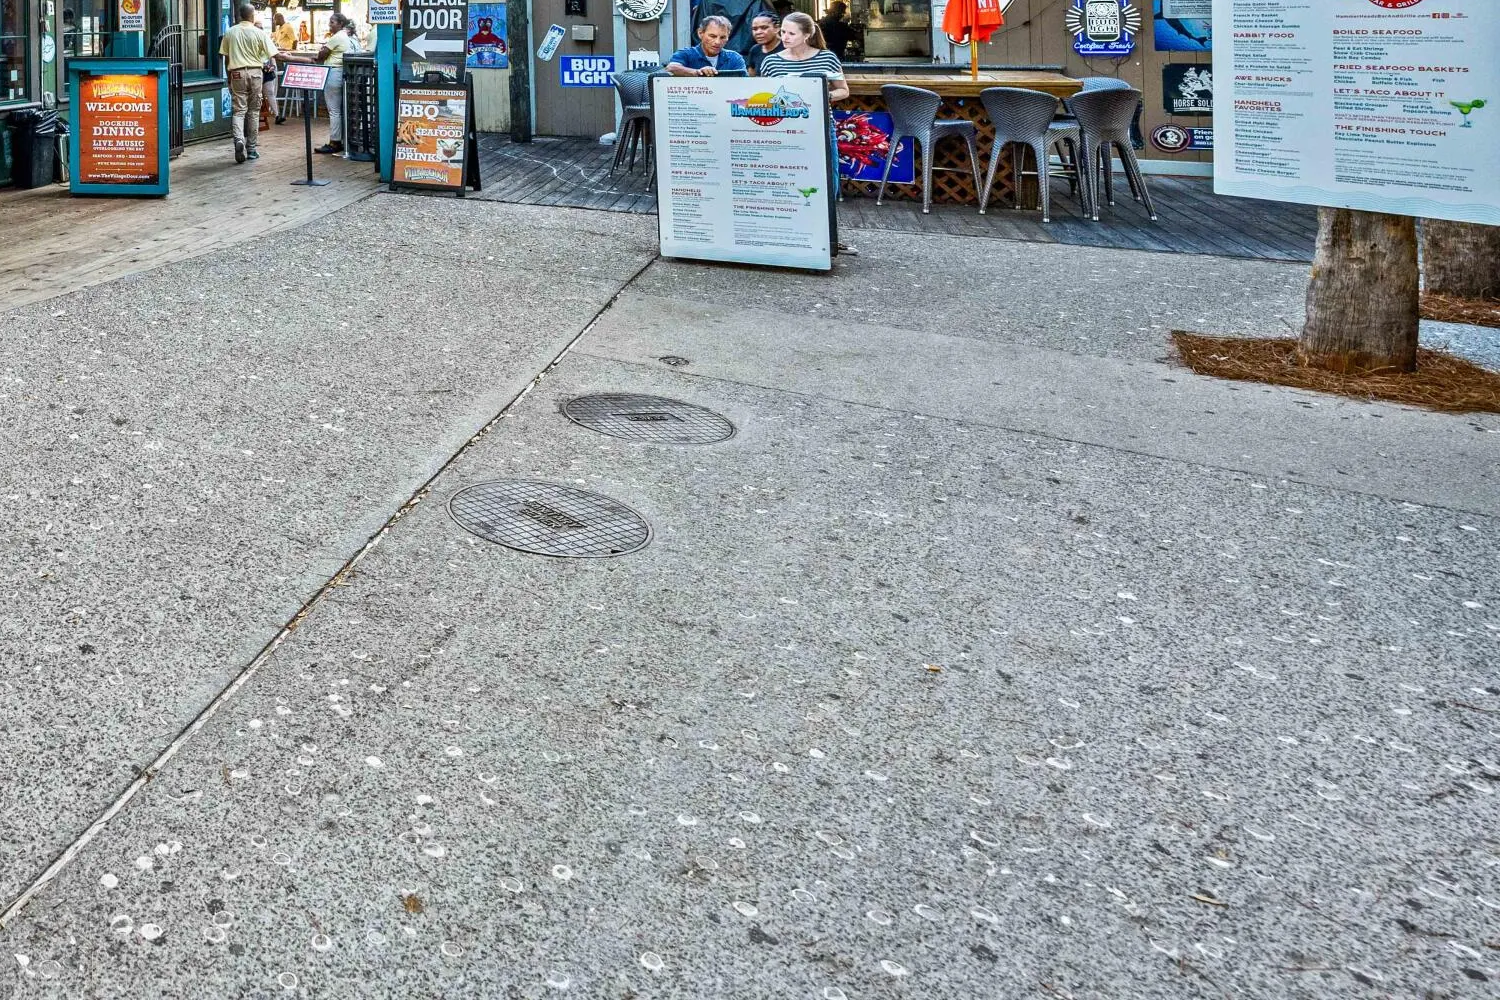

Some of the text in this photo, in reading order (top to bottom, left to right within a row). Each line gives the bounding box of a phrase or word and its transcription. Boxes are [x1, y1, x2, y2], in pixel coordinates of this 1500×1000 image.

[624, 8, 643, 19] HARD
[410, 9, 462, 29] DOOR
[1089, 18, 1118, 26] BUD
[570, 59, 611, 71] BUD
[85, 103, 152, 112] WELCOME
[1174, 99, 1195, 107] HORSE
[401, 104, 440, 121] BBQ
[93, 127, 145, 136] DINING
[416, 128, 463, 137] SEAFOOD
[1356, 126, 1406, 134] FINISHING
[1409, 129, 1446, 137] TOUCH
[397, 152, 442, 162] DRINKS
